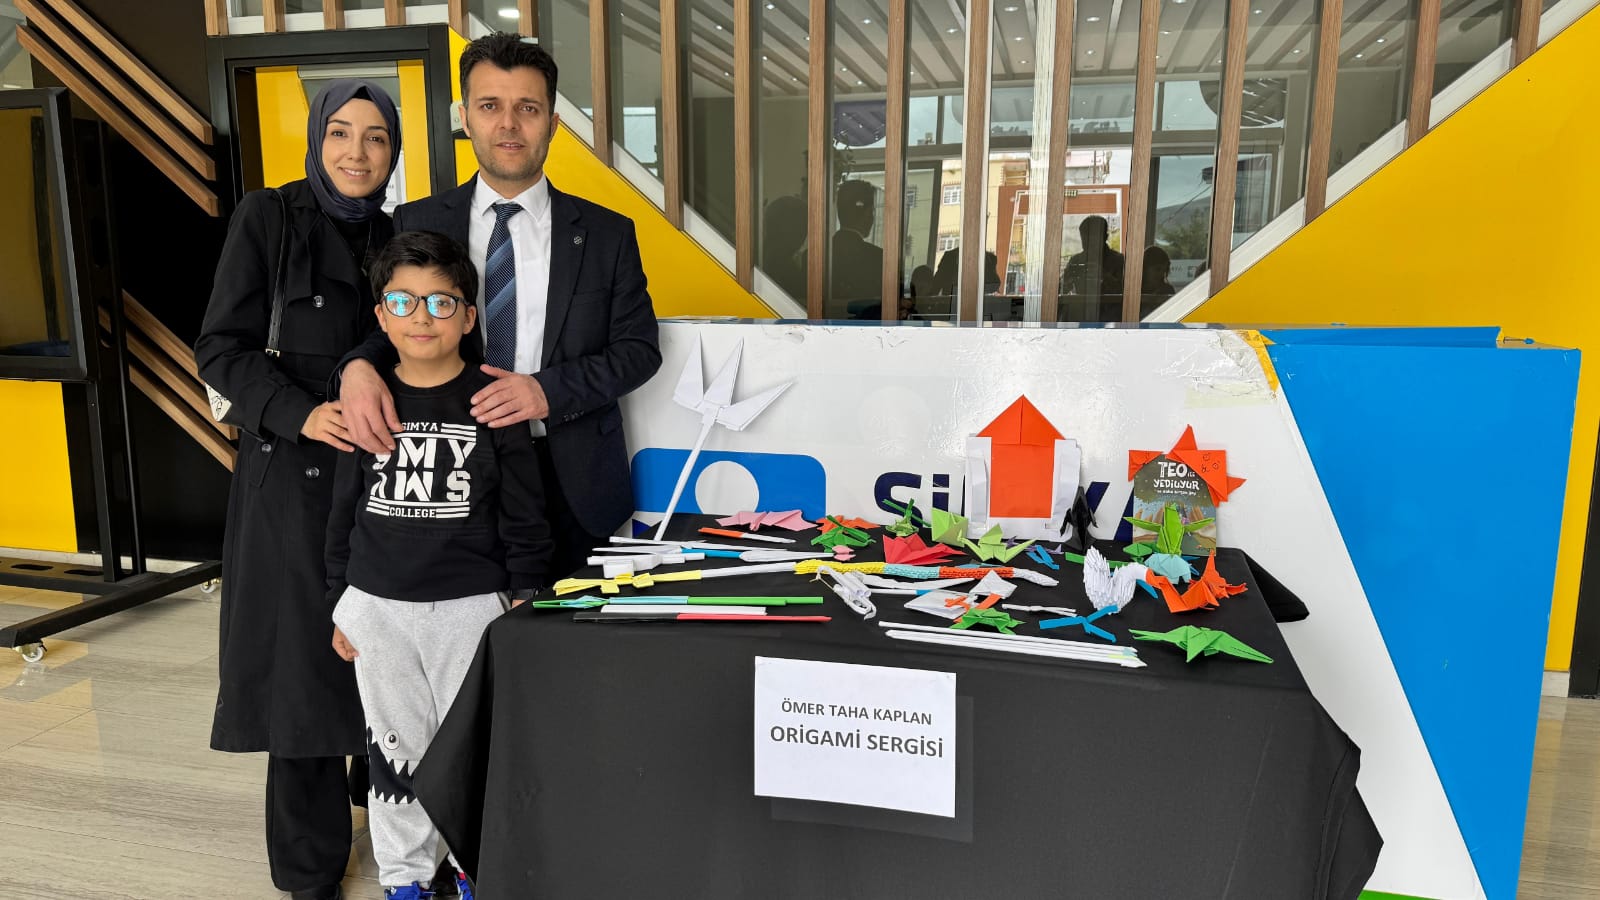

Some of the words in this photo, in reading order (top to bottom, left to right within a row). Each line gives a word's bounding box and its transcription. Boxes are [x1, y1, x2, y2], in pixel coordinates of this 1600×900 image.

[1157, 461, 1188, 478] TEO
[389, 507, 437, 518] COLLEGE
[781, 697, 825, 716] ÖMER
[828, 704, 869, 720] TAHA
[873, 708, 932, 725] KAPLAN
[770, 724, 861, 749] ORİGAMİ
[867, 733, 943, 758] SERGİSİ
